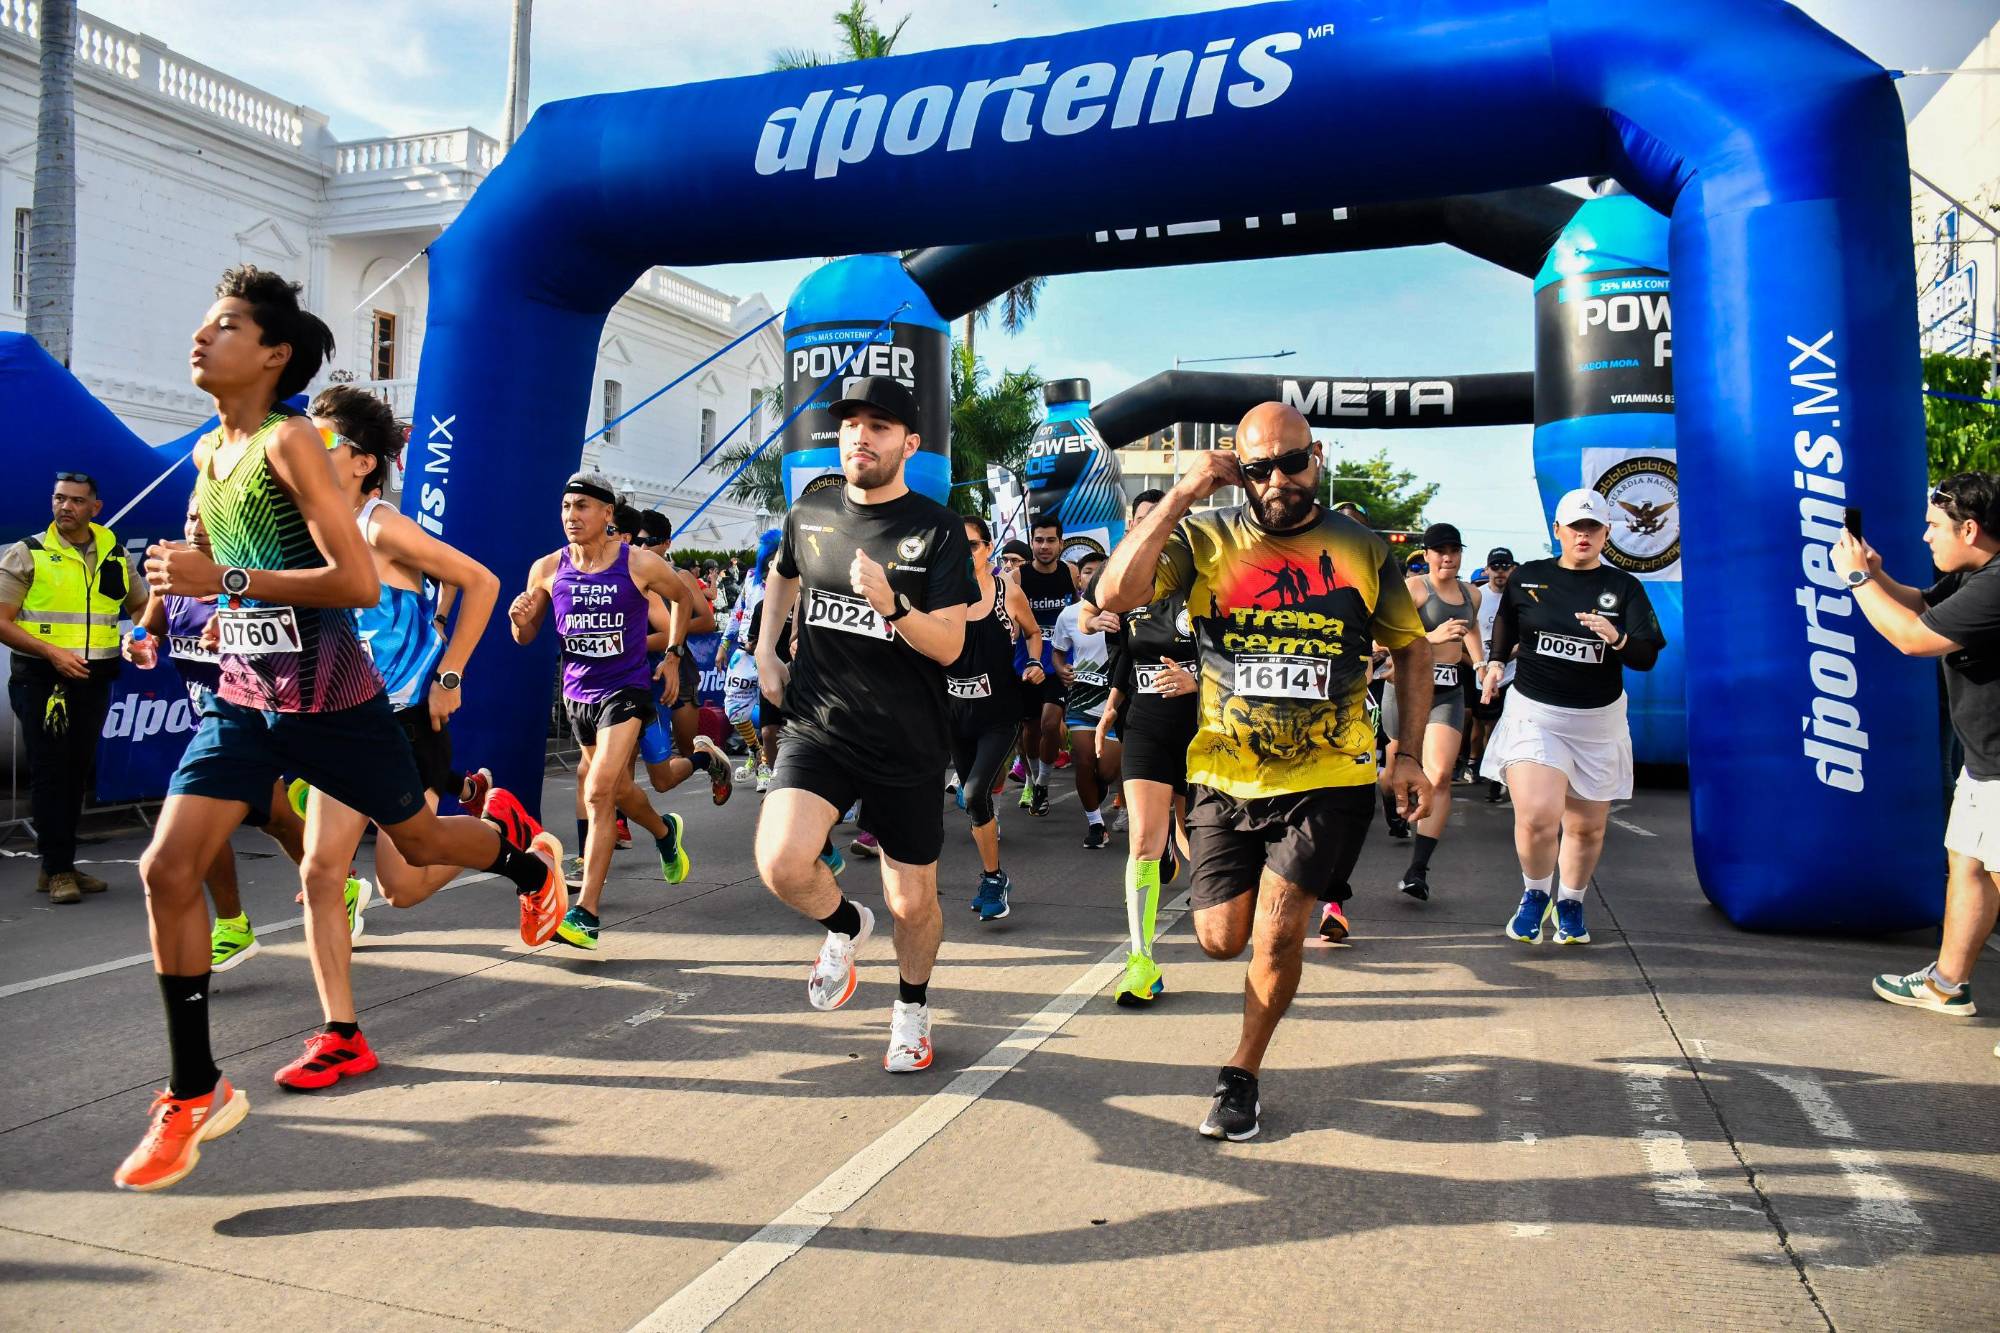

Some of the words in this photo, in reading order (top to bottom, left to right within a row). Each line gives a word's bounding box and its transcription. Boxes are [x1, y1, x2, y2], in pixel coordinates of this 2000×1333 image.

[755, 31, 1302, 180] dportenis
[1308, 24, 1335, 40] MR
[1600, 282, 1620, 292] 25%
[793, 345, 915, 382] POWER
[1610, 358, 1640, 369] MORA
[1282, 379, 1454, 418] META
[1610, 394, 1663, 404] VITAMINAS
[811, 431, 840, 441] VITAMIN
[1028, 434, 1096, 458] POWER
[1608, 477, 1644, 507] GUARDIA
[569, 584, 618, 595] TEAM
[572, 593, 612, 606] PIÑA
[565, 612, 624, 629] MARCELO
[811, 600, 876, 631] 0024
[223, 621, 279, 647] 0760
[1041, 629, 1055, 638] 23
[1223, 632, 1344, 655] cerros
[172, 638, 213, 657] 046
[567, 638, 607, 653] 0641
[1540, 637, 1588, 659] 0091
[1239, 665, 1310, 692] 1614
